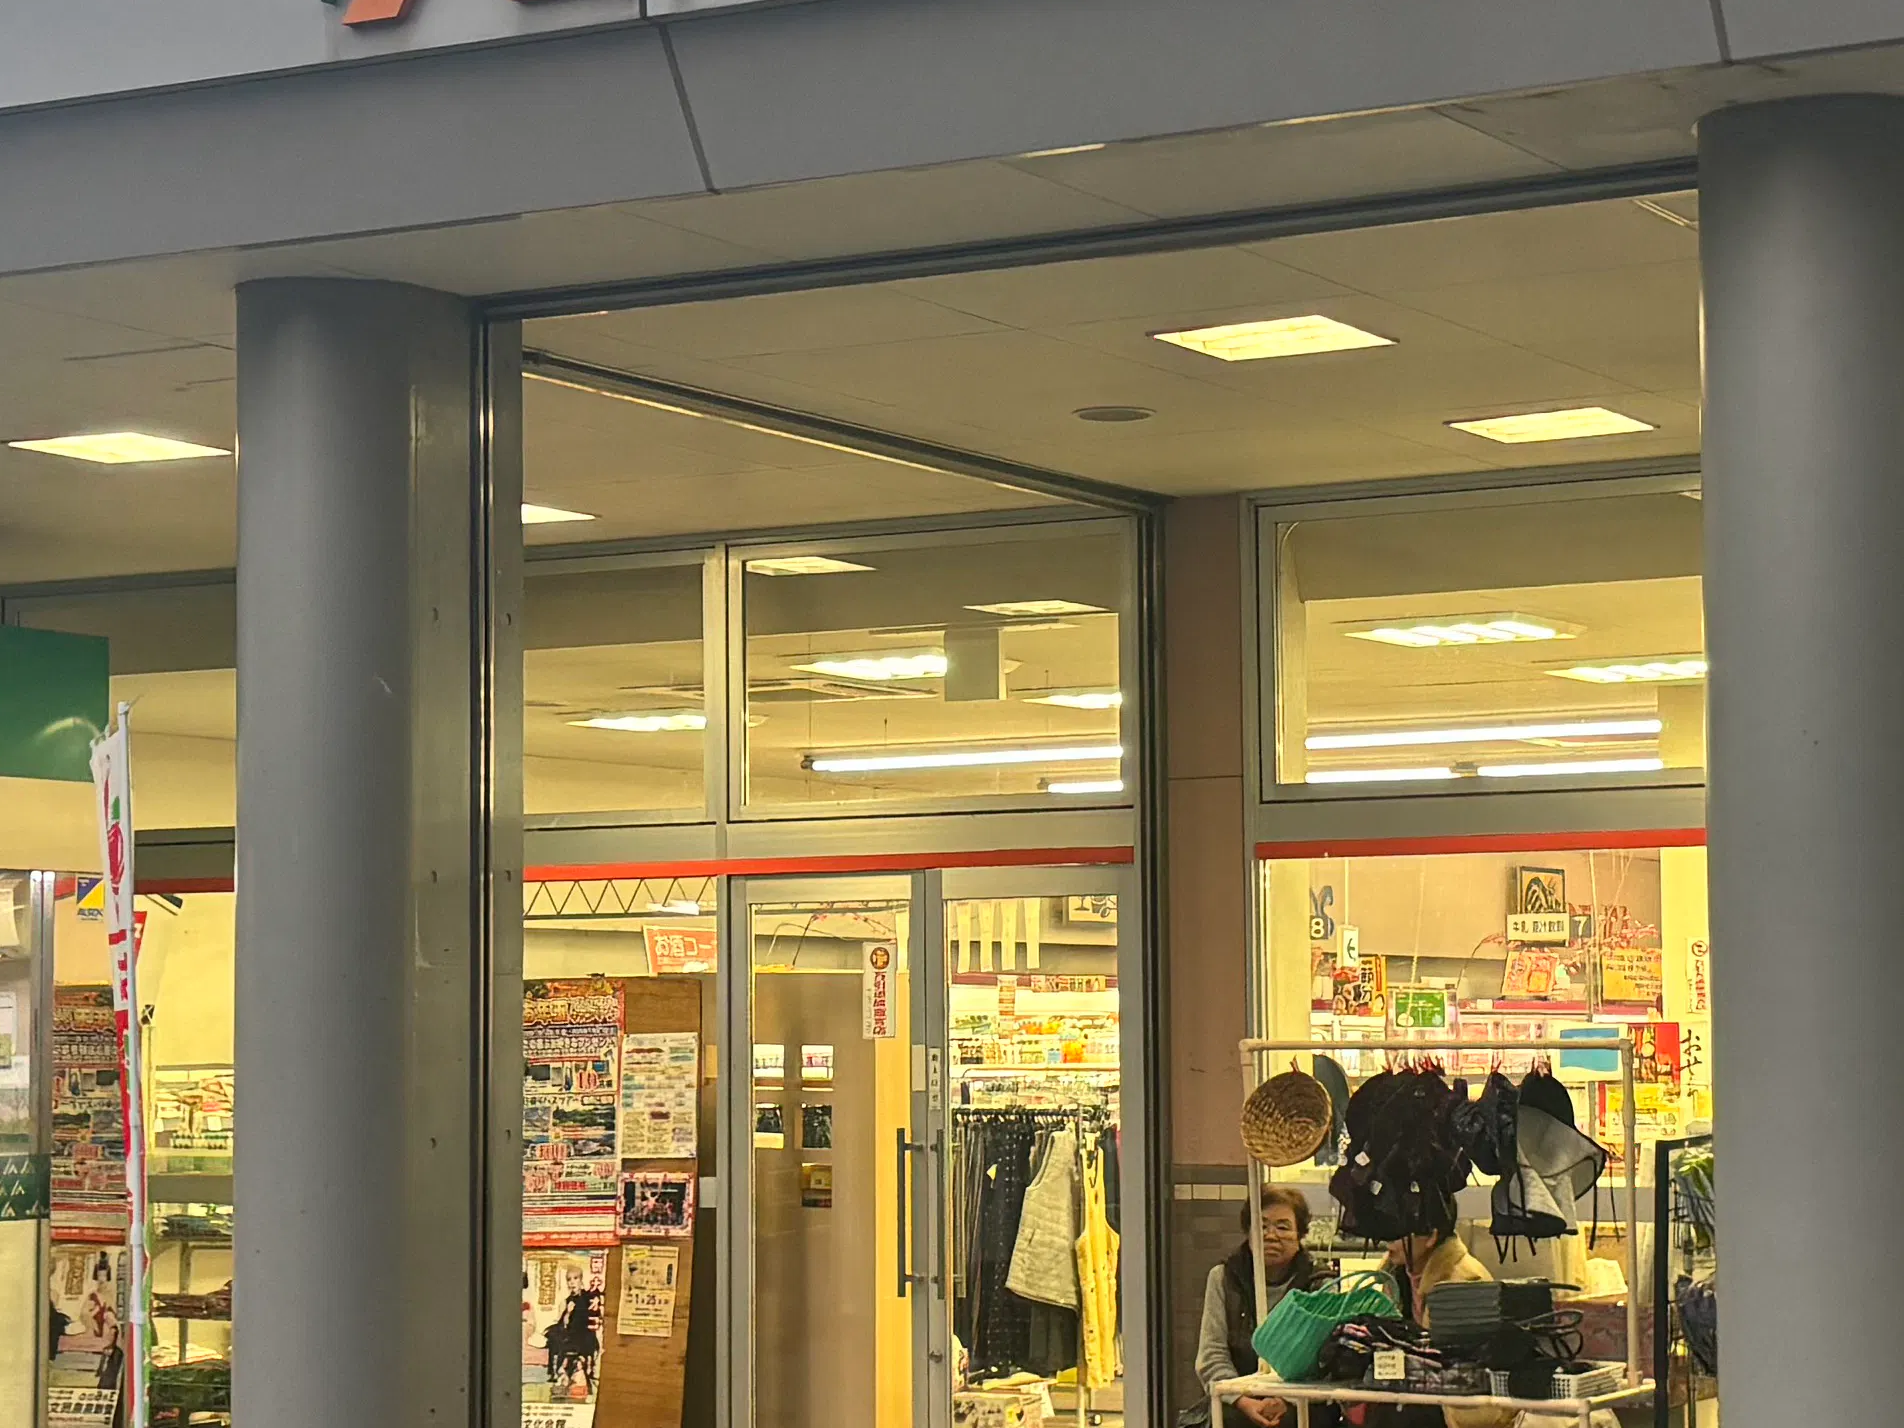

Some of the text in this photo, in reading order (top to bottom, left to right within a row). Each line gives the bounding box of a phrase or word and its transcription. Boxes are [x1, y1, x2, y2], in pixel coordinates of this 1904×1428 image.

[1311, 917, 1325, 939] 8
[1573, 916, 1589, 936] 7
[654, 933, 717, 958] お酒コー
